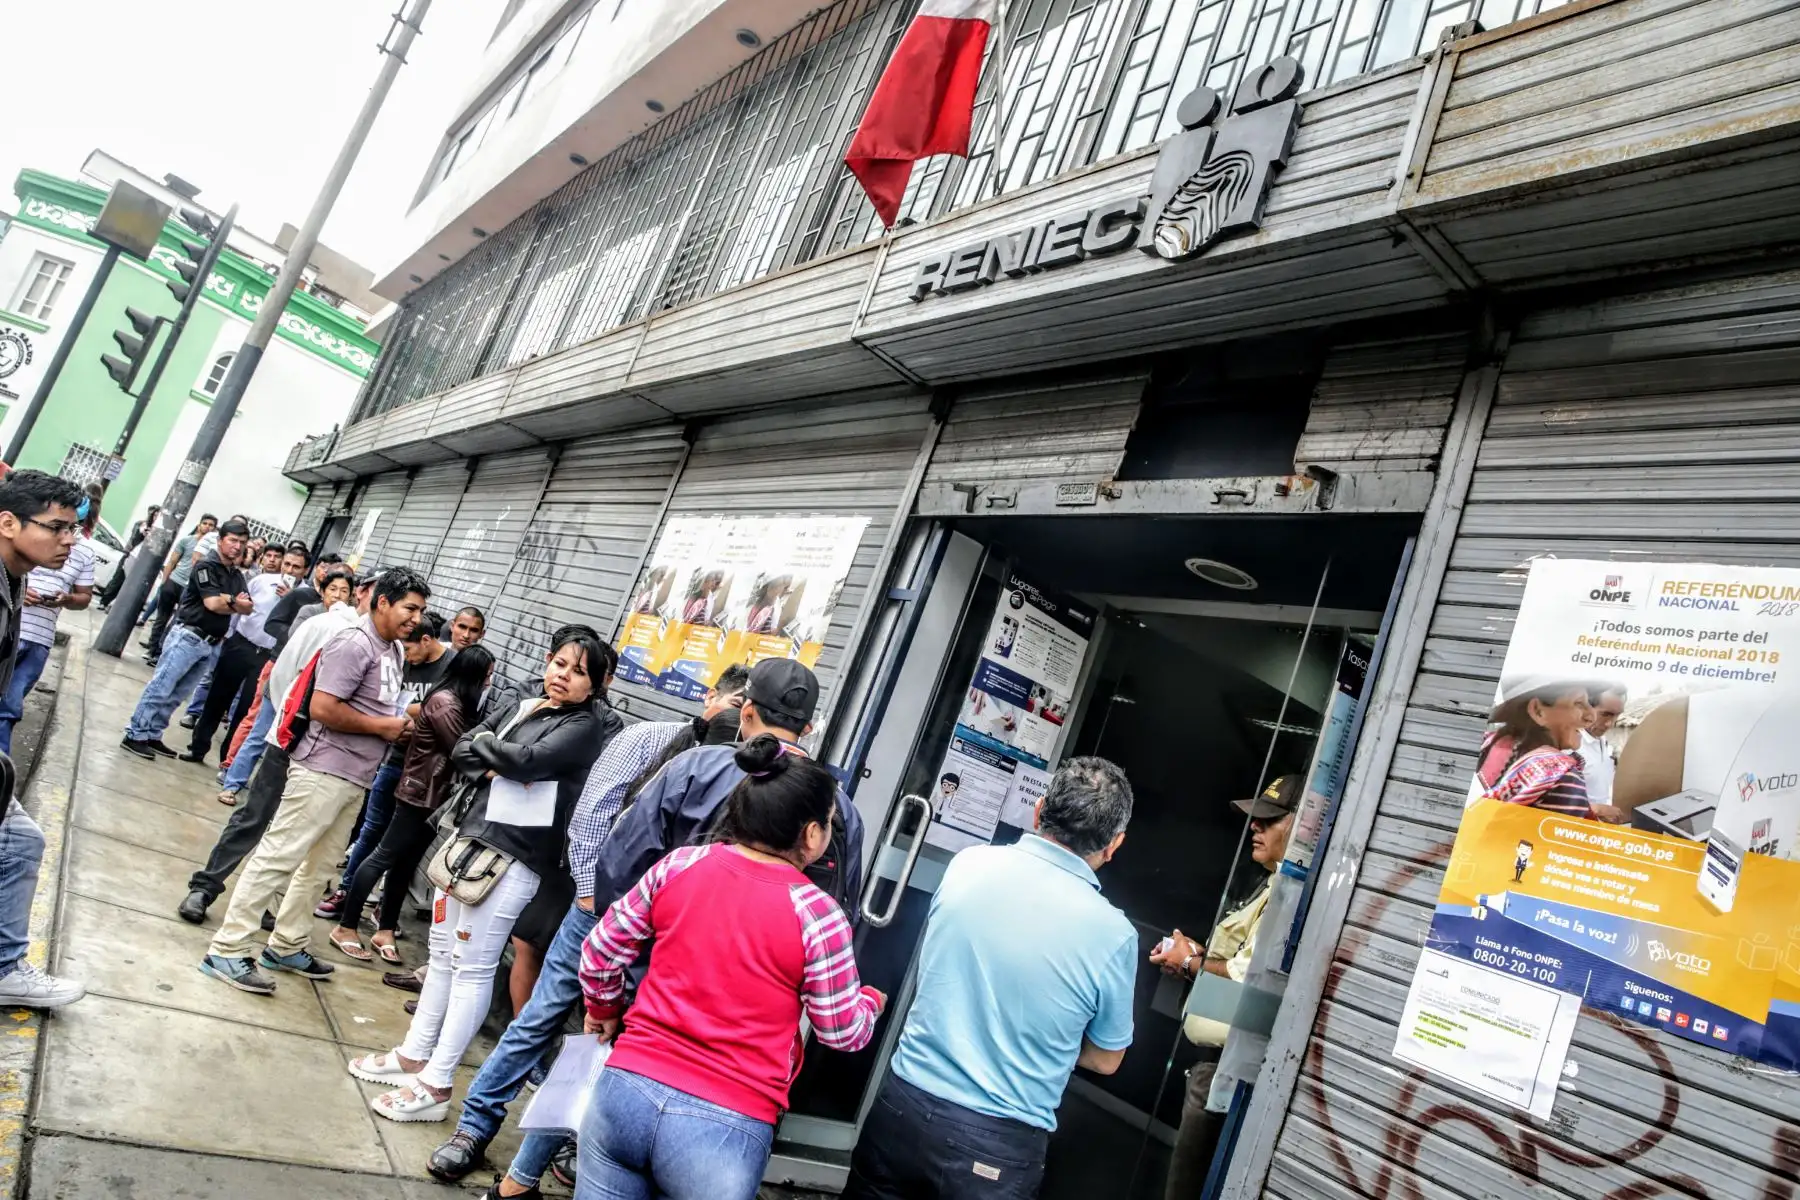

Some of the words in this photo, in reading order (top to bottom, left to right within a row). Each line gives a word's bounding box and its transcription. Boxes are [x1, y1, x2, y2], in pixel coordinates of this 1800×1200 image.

[907, 197, 1147, 302] RENIEC
[1589, 589, 1632, 602] ONPE
[1658, 596, 1740, 612] NACIONAL
[1756, 601, 1800, 617] 2018
[1593, 619, 1641, 634] ¡Todos
[1645, 624, 1694, 639] somos
[1697, 628, 1739, 643] parte
[1742, 630, 1769, 645] del
[1576, 634, 1662, 655] Referéndum
[1665, 643, 1734, 661] Nacional
[1736, 649, 1781, 665] 2018
[1571, 651, 1592, 664] del
[1594, 656, 1653, 672] próximo
[1656, 660, 1667, 673] 9
[1669, 661, 1689, 675] de
[1692, 664, 1778, 684] diciembre!
[1758, 773, 1798, 792] voto
[1553, 825, 1674, 862] www.onpe.gob.pe
[1601, 878, 1627, 892] votar
[1534, 908, 1571, 929] ¡Pasa
[1573, 919, 1586, 934] la
[1588, 926, 1619, 945] voz!
[1472, 947, 1557, 984] 0800-20-100
[1475, 935, 1502, 951] Llama
[1503, 944, 1510, 953] a
[1510, 946, 1533, 961] Fono
[1534, 953, 1563, 970] ONPE:
[1666, 948, 1712, 972] voto
[1623, 980, 1674, 1004] Síguenos:
